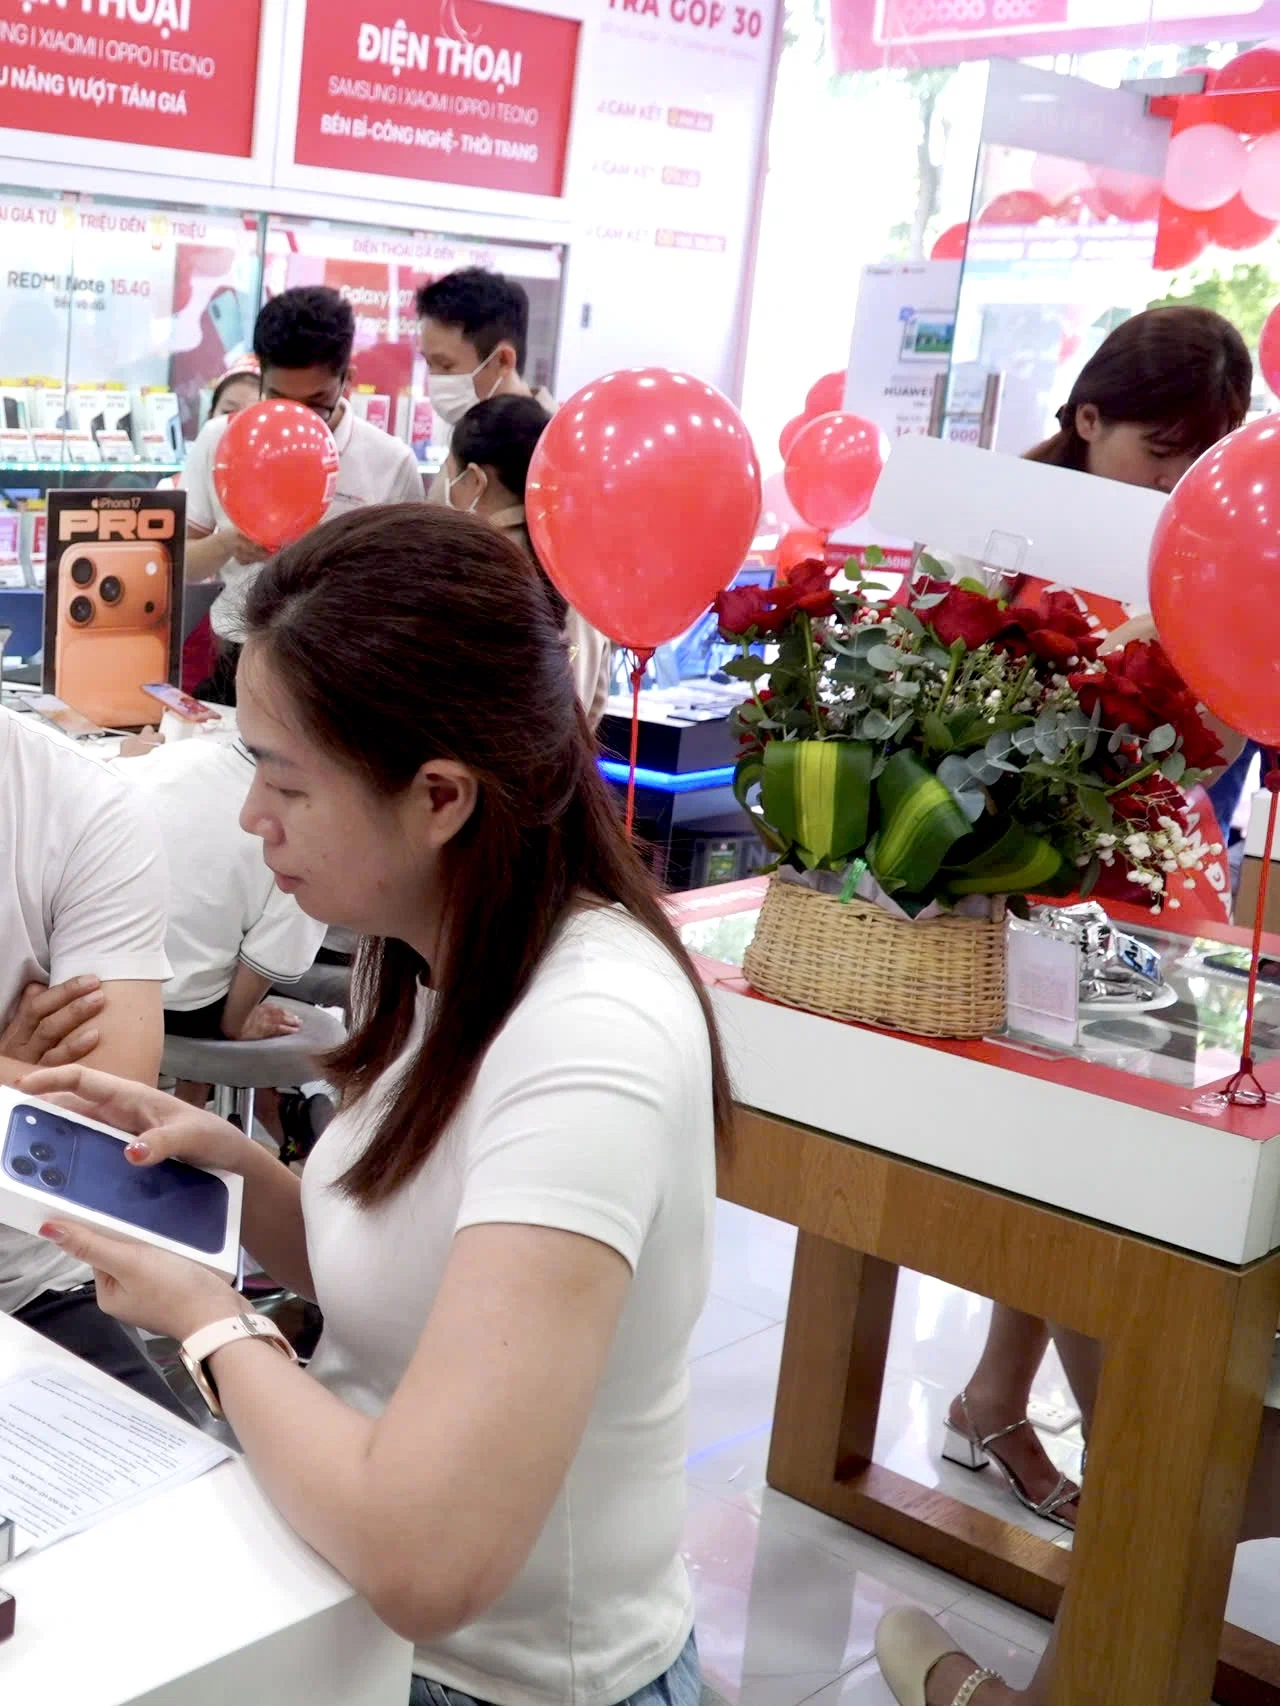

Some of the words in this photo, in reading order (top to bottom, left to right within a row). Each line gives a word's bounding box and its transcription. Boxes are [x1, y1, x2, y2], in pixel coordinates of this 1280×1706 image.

[733, 6, 762, 38] 30
[38, 26, 96, 58] XIAOMI
[105, 39, 152, 68] OPPO
[160, 48, 215, 78] TECNO
[358, 18, 430, 76] ĐIỆN
[435, 36, 522, 94] THOẠI
[11, 64, 65, 96] NĂNG
[158, 89, 188, 116] GIÁ
[328, 75, 397, 105] SAMSUNG
[65, 275, 105, 294] Note
[131, 496, 142, 508] 17
[59, 509, 175, 540] PRO
